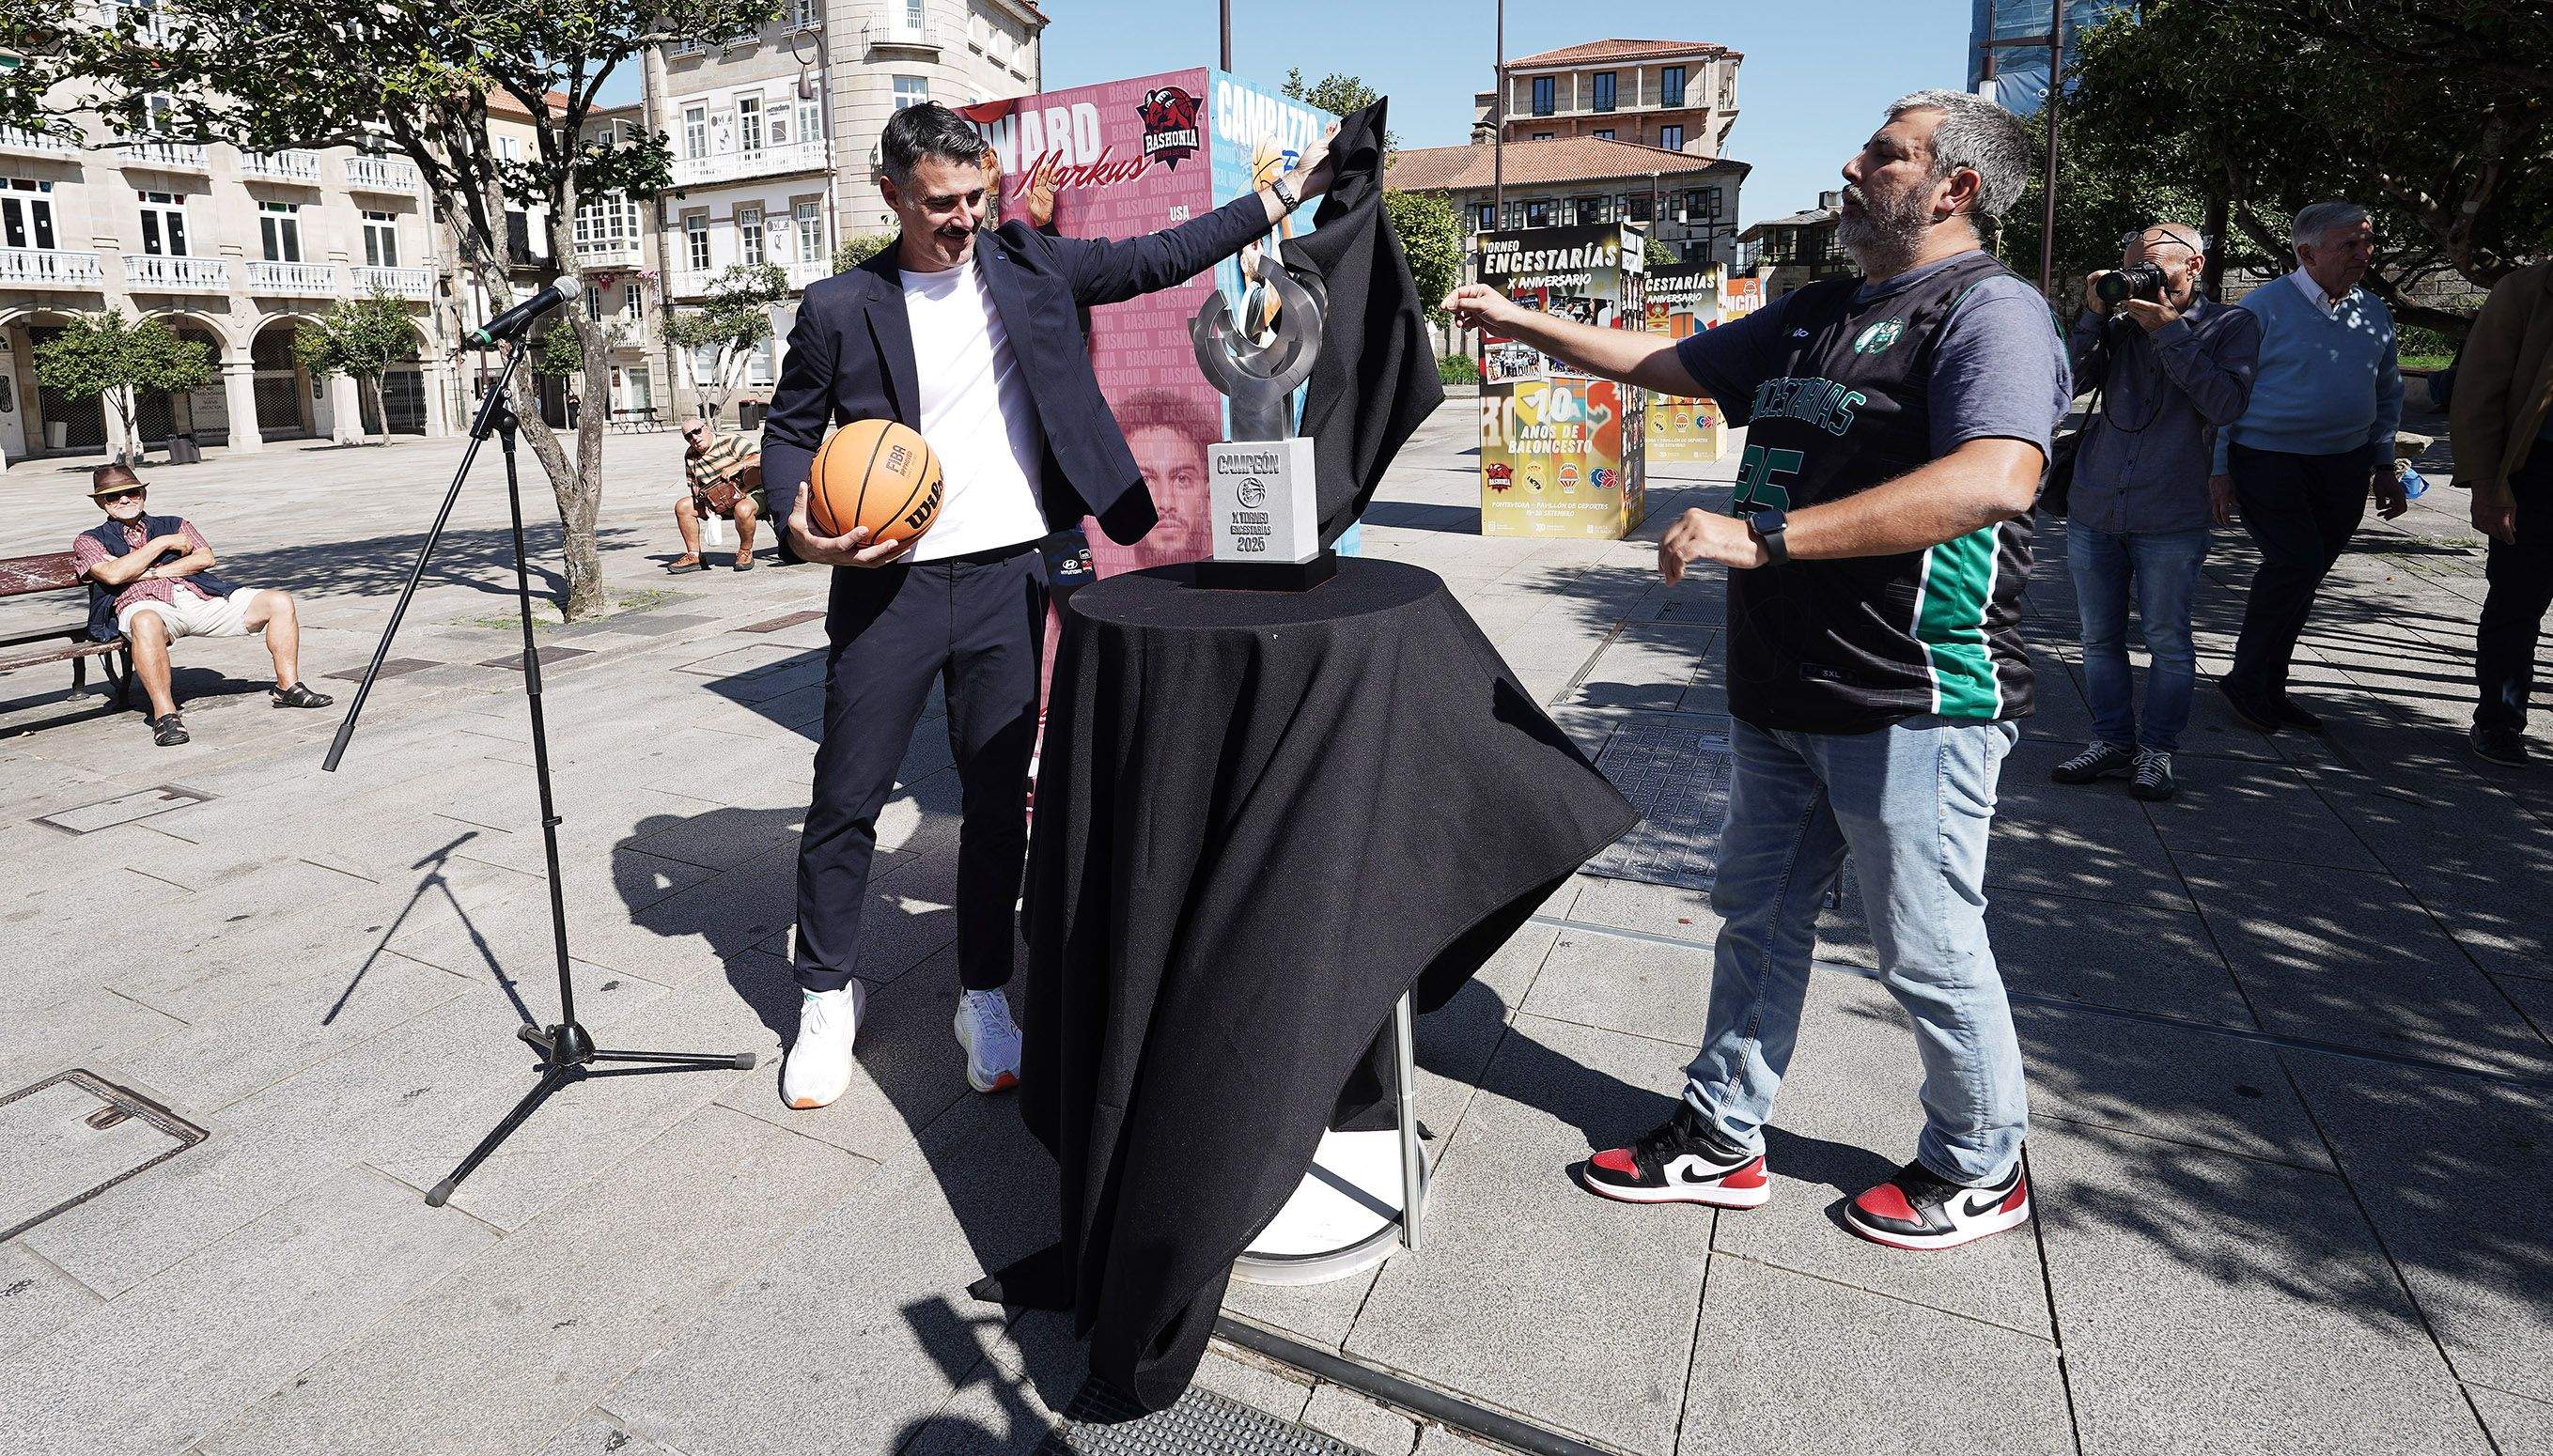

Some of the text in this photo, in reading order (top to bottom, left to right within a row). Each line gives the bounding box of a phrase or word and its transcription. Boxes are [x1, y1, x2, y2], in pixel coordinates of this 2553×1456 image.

[1170, 205, 1190, 221] USA
[1484, 240, 1520, 254] TORNEO
[1485, 242, 1618, 274] ENCESTARÍAS
[1506, 273, 1593, 290] X ANIVERSARIO
[1644, 272, 1716, 292] CESTARÍAS
[1646, 292, 1703, 304] ANIVERSARIO
[1097, 331, 1148, 349] BASKONIA
[1126, 349, 1178, 366] BASKONIA
[1563, 425, 1580, 439] DE
[1508, 439, 1594, 454] BALONCESTO
[885, 444, 907, 473] FIBA
[1217, 450, 1280, 474] CAMPEÓN
[1231, 512, 1269, 524] X TORNEO
[1230, 524, 1272, 535] ENCESTARÍAS
[1237, 536, 1266, 551] 2025
